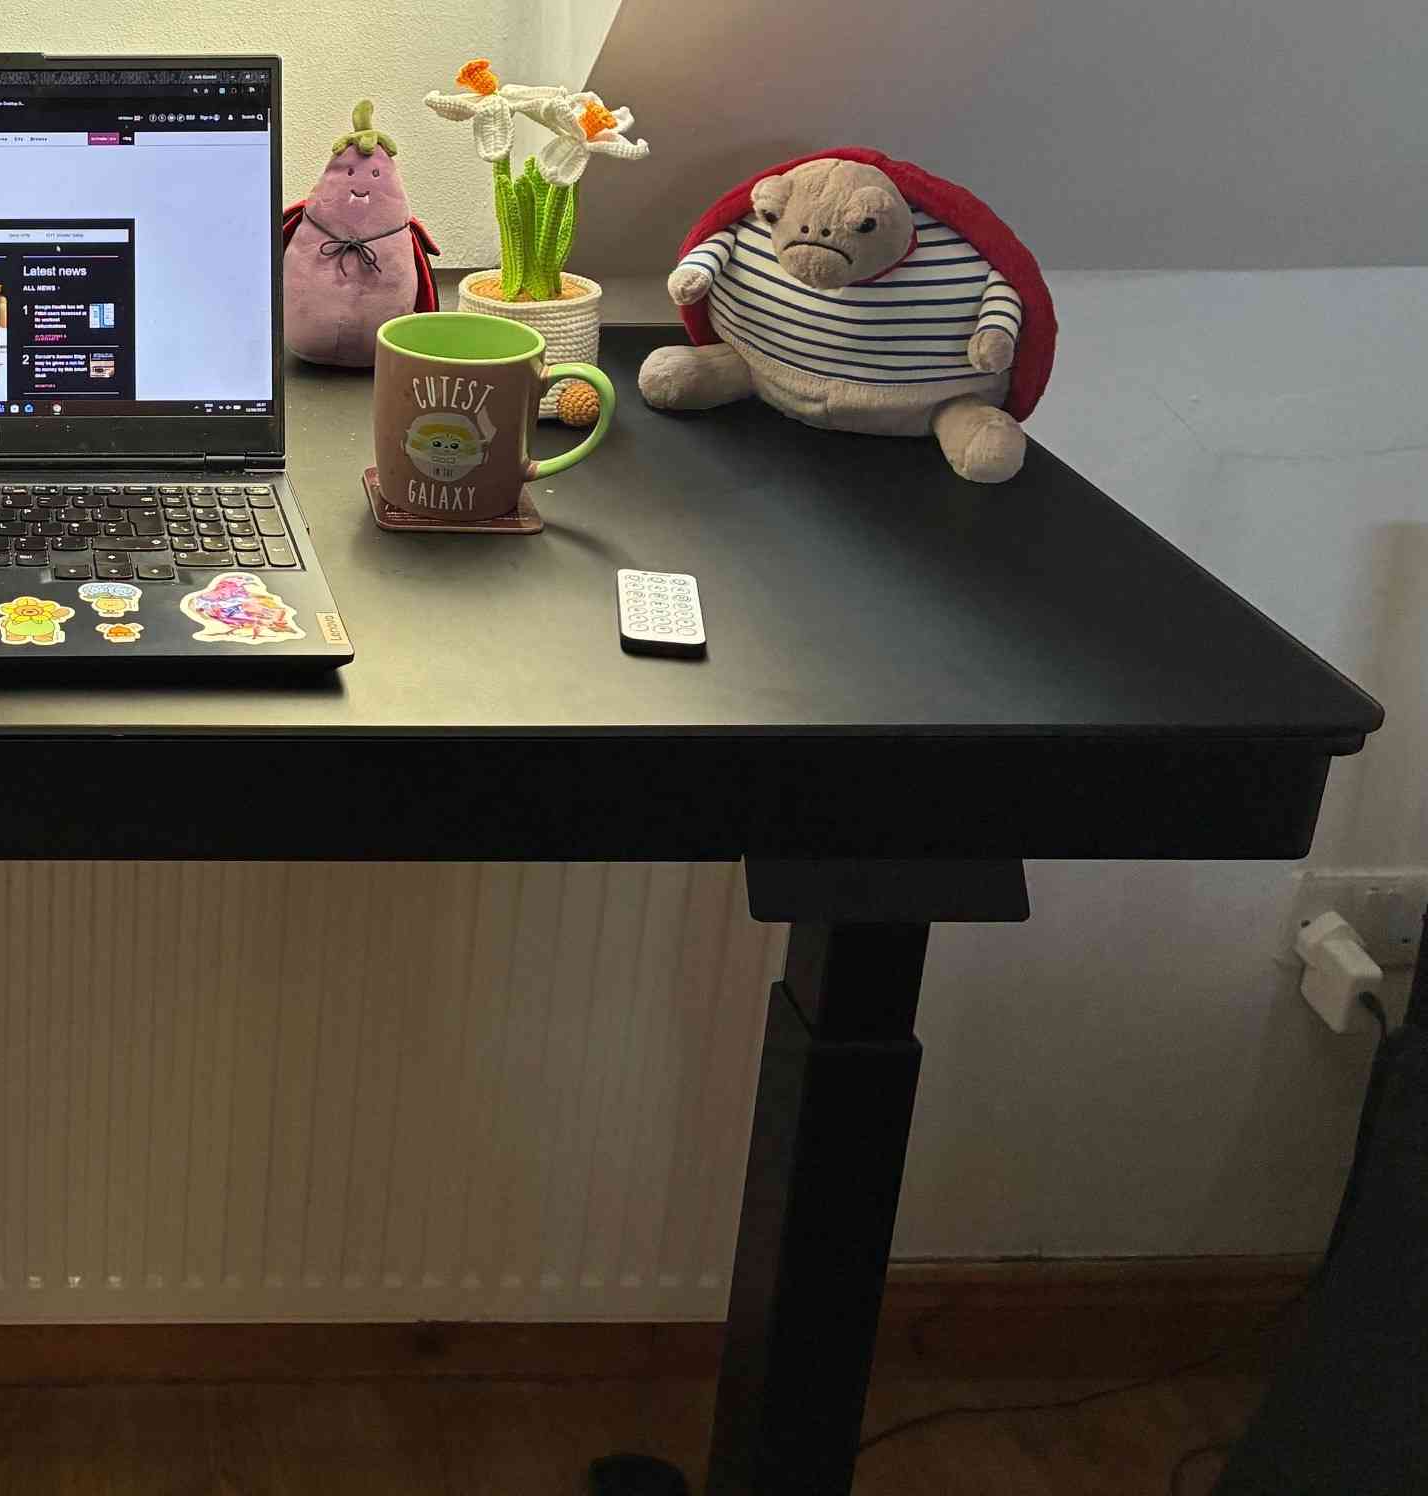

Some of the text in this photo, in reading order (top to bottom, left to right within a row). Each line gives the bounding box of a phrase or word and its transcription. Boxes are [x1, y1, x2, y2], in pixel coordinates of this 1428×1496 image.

[23, 266, 87, 277] Latest news
[22, 304, 28, 315] 1
[22, 354, 30, 365] 2
[412, 375, 495, 414] CUTEST
[408, 479, 476, 511] GALAXY
[324, 615, 342, 641] Lenovo
